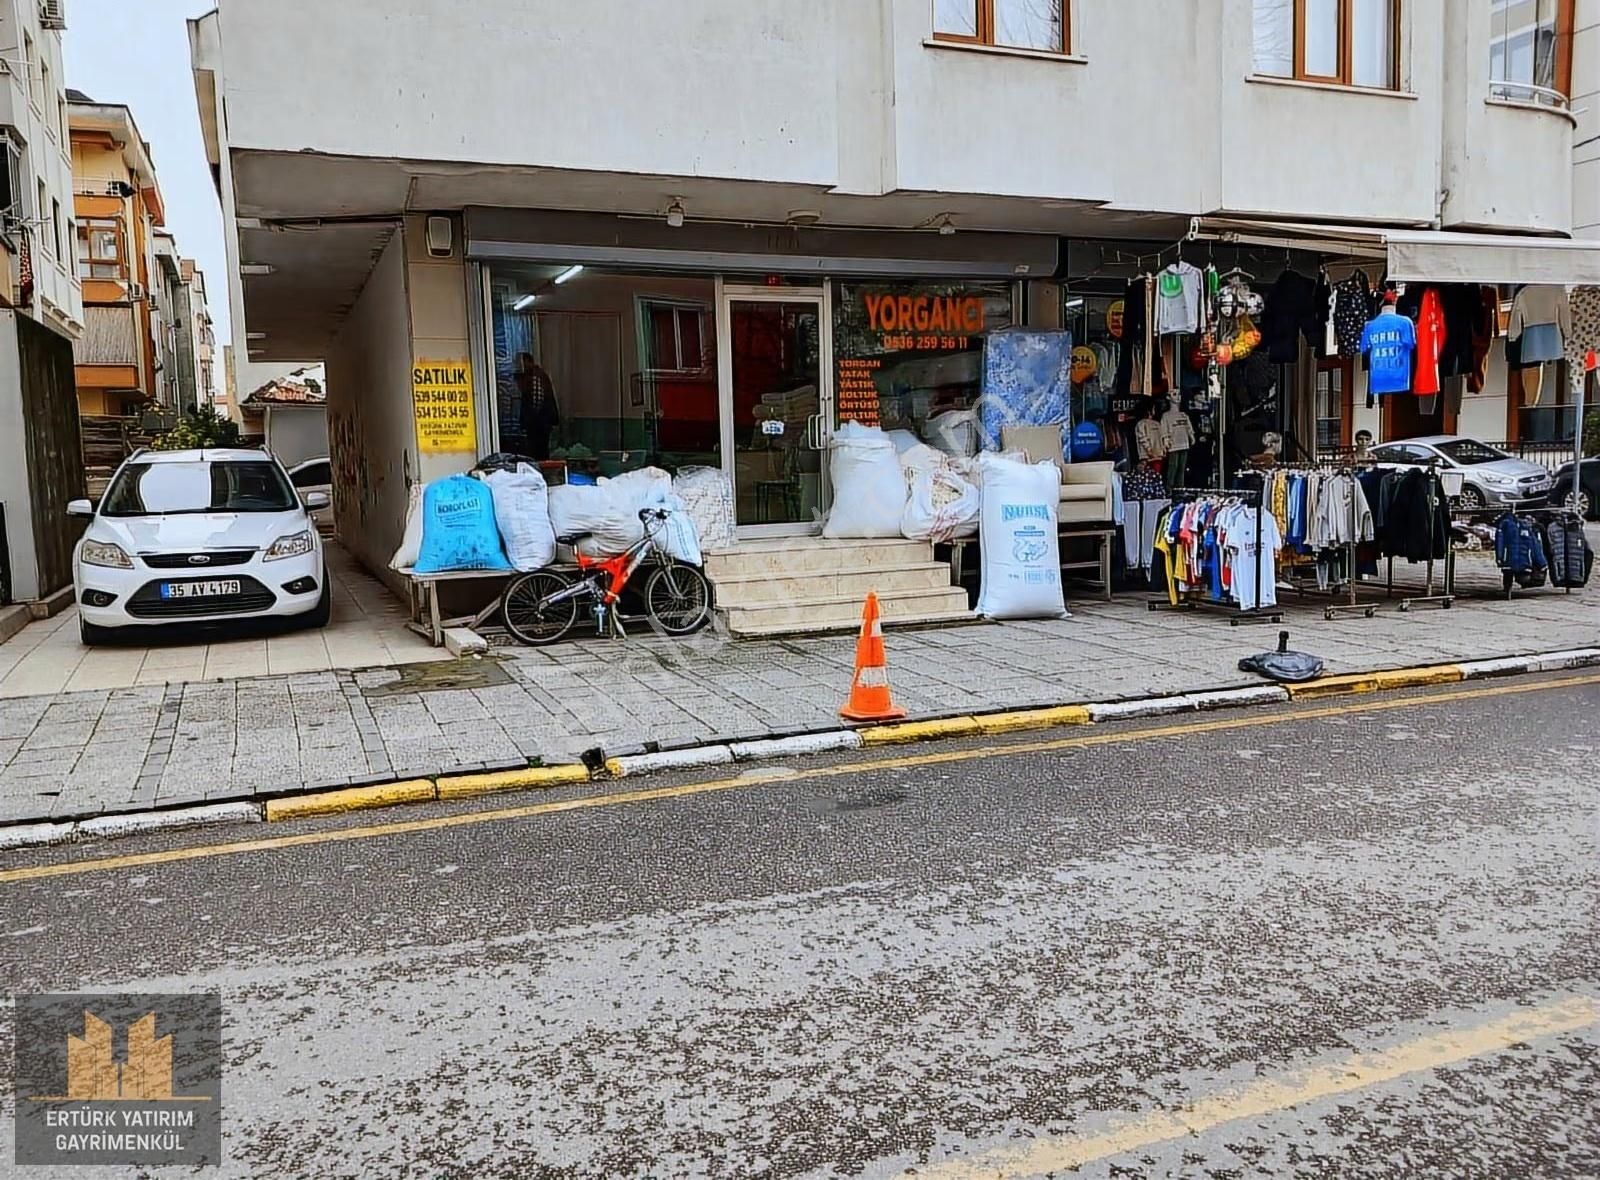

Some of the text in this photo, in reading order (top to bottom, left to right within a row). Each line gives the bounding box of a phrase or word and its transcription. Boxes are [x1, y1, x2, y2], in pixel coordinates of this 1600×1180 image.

[864, 295, 985, 332] YORGANCI
[916, 336, 937, 349] 259
[941, 336, 955, 349] 56
[958, 336, 968, 350] 11
[413, 368, 467, 385] SATILIK
[839, 370, 870, 378] YATAK
[839, 391, 878, 399] KOLTUK
[839, 411, 878, 419] KOLTUK
[170, 585, 184, 597] 35
[210, 582, 238, 595] 4179
